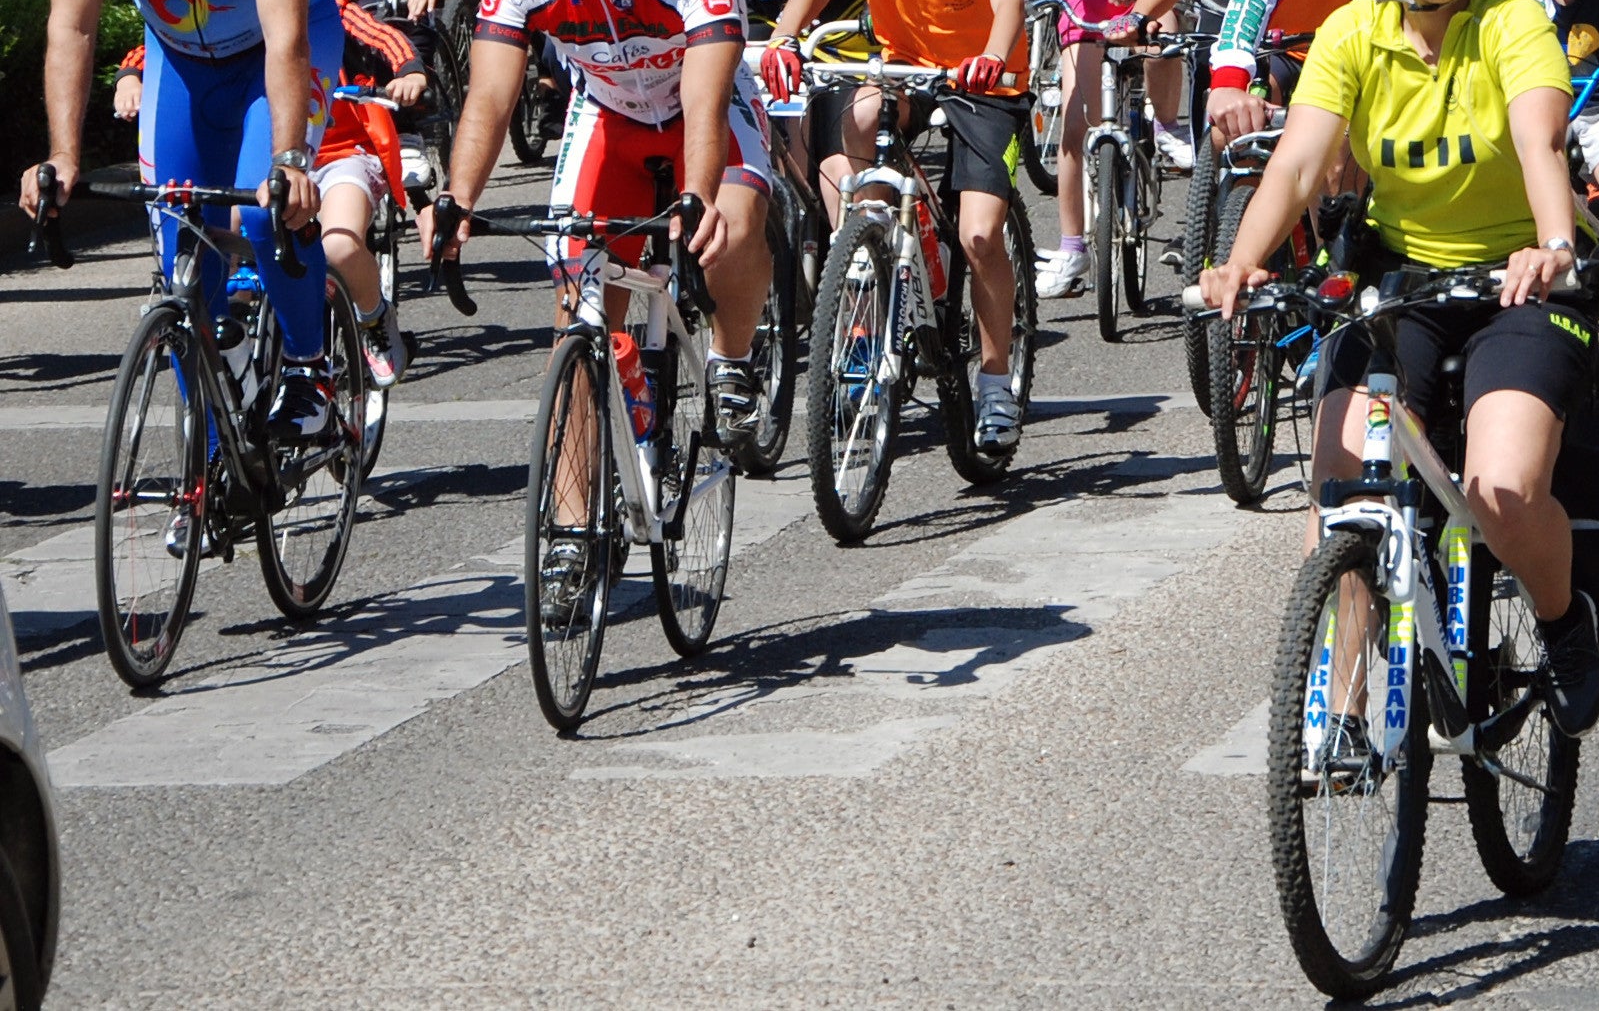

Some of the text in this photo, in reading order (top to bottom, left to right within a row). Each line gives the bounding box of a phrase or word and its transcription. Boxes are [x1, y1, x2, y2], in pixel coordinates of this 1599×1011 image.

[591, 45, 650, 68] Cafés
[1447, 566, 1466, 645] UBAM
[1385, 646, 1408, 729] UBAM
